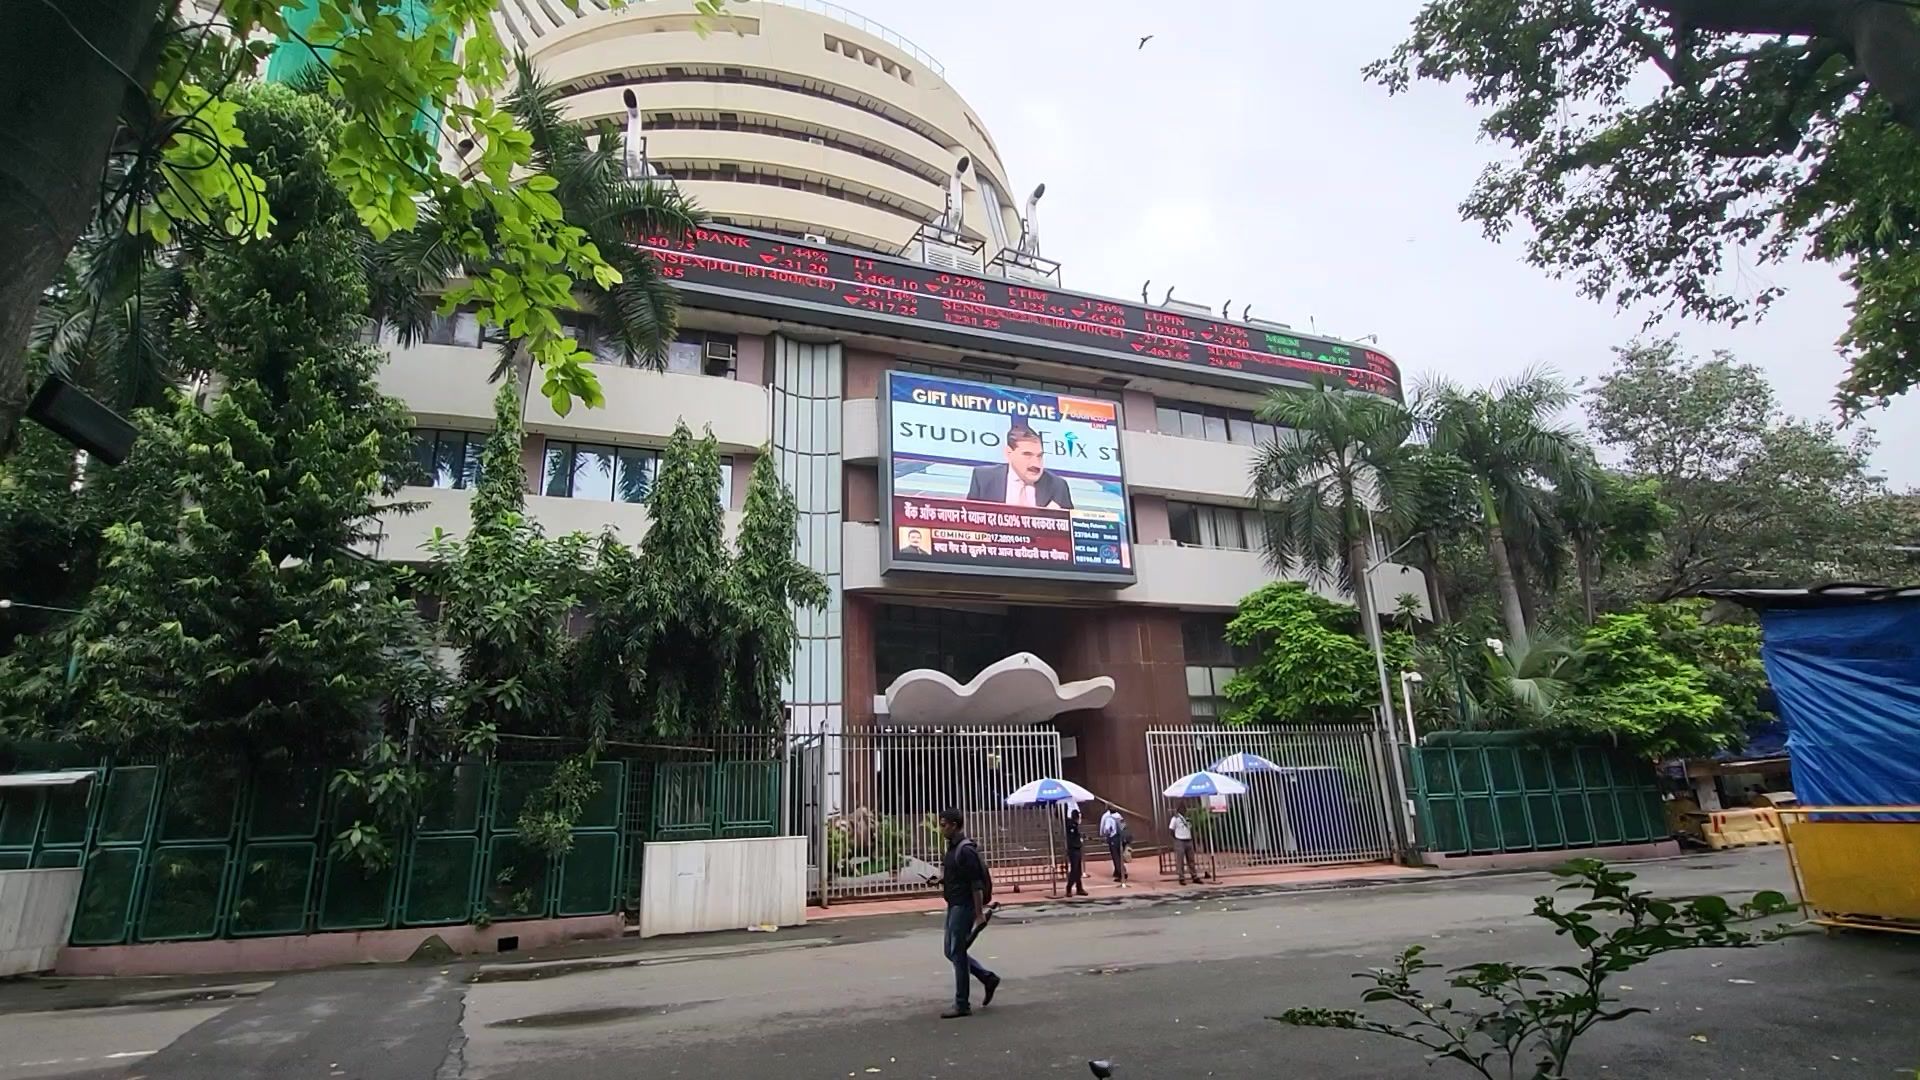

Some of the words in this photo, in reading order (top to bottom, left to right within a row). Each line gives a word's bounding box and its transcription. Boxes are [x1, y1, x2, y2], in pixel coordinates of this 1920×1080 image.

[1144, 312, 1186, 326] LUPIN
[912, 388, 948, 406] GIFT
[951, 394, 993, 412] NIFTY
[997, 400, 1056, 420] UPDATE
[899, 421, 1000, 448] STUDIO
[933, 530, 971, 541] COMING
[974, 532, 988, 541] UP
